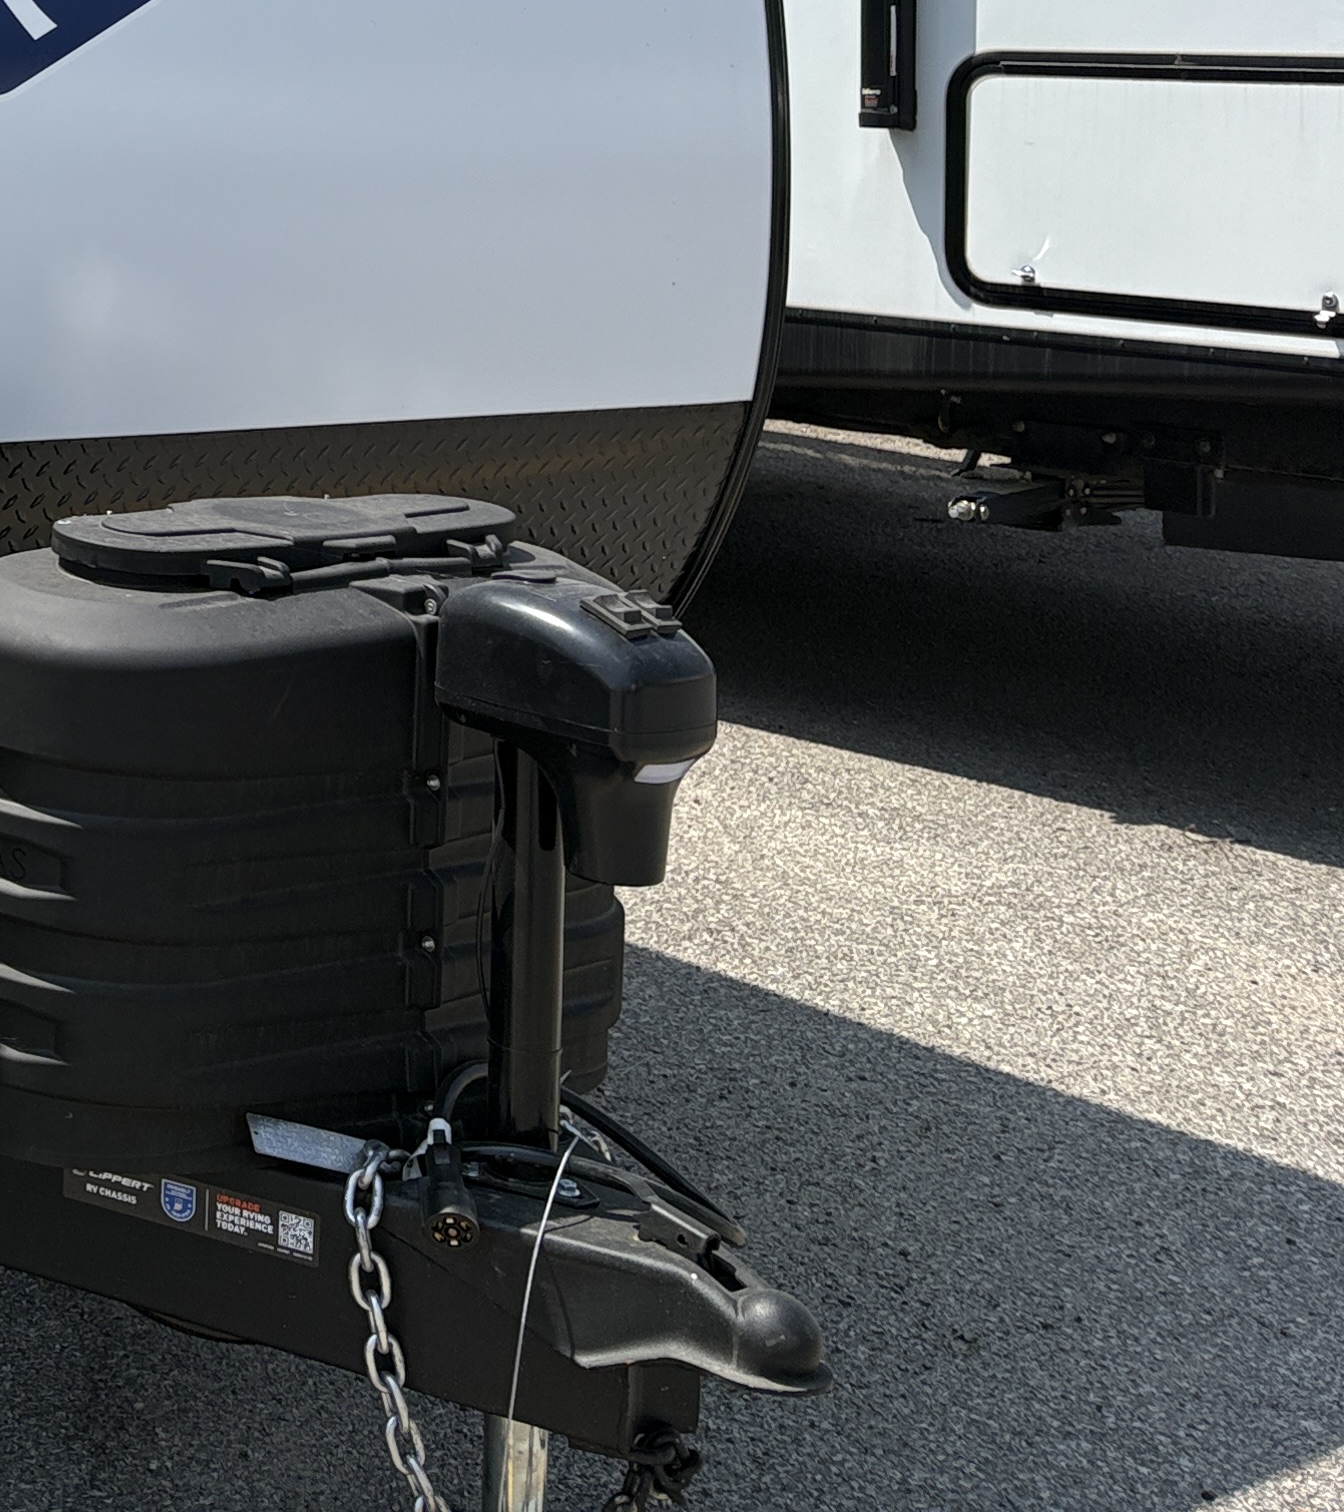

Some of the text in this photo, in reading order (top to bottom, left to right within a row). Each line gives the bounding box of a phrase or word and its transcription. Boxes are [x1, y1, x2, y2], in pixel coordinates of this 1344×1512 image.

[88, 1170, 154, 1192] LIPPERT
[85, 1183, 137, 1205] RV CHASSIS
[216, 1194, 260, 1212] UPGRADE
[216, 1202, 271, 1224] YOUR RVING
[216, 1210, 274, 1235] EXPERIENCE
[216, 1219, 248, 1236] TODAY.
